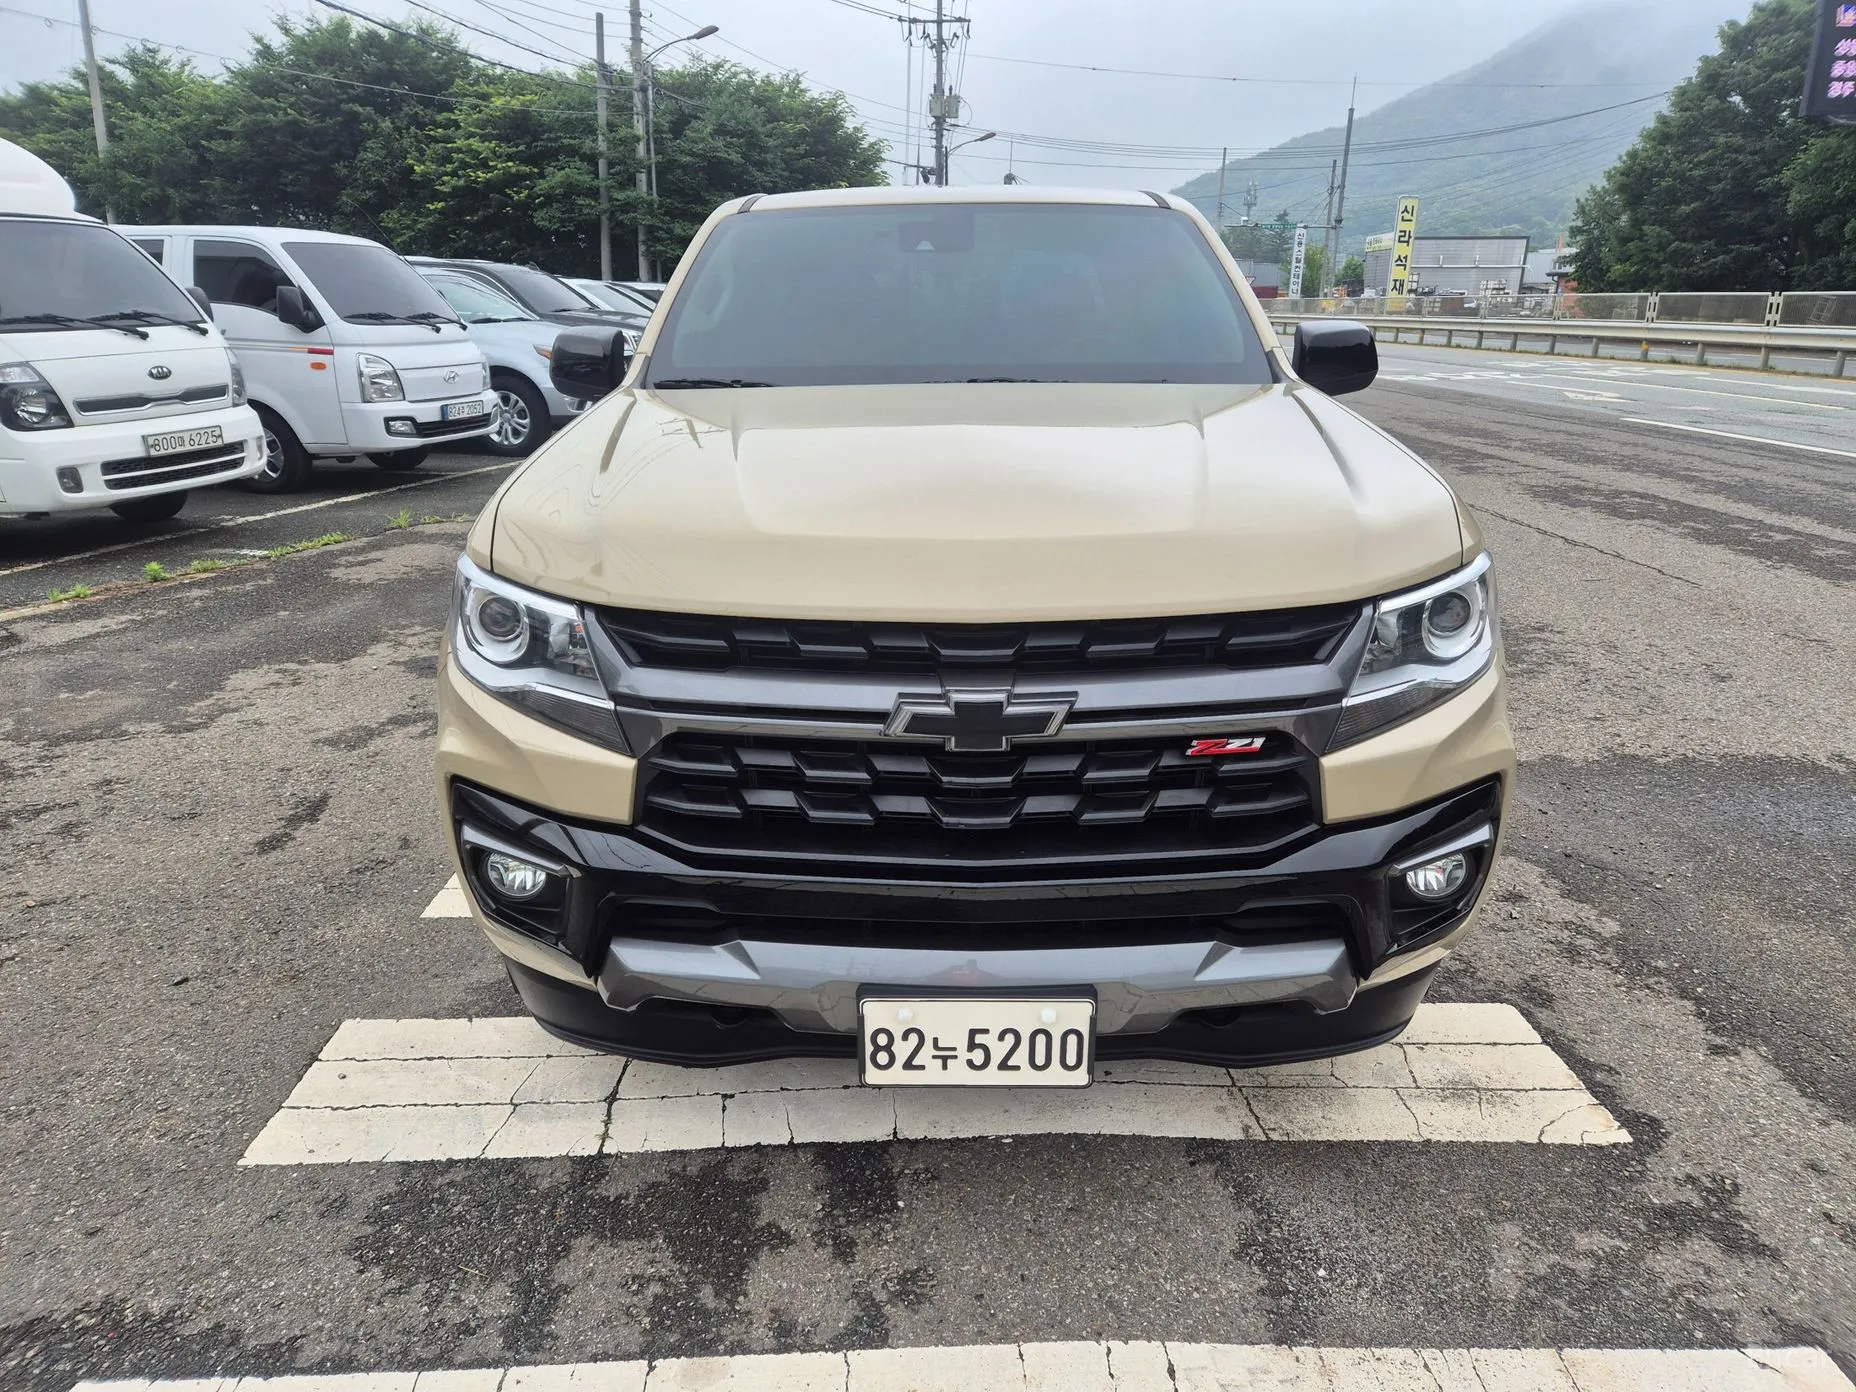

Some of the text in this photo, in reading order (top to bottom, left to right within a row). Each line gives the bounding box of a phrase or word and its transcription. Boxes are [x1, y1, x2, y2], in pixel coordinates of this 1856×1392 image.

[1391, 205, 1415, 295] 신라석재
[150, 367, 170, 378] KIA
[153, 430, 218, 452] 800마 6225
[1185, 737, 1266, 756] Z71
[869, 1027, 1085, 1072] 82누5200
